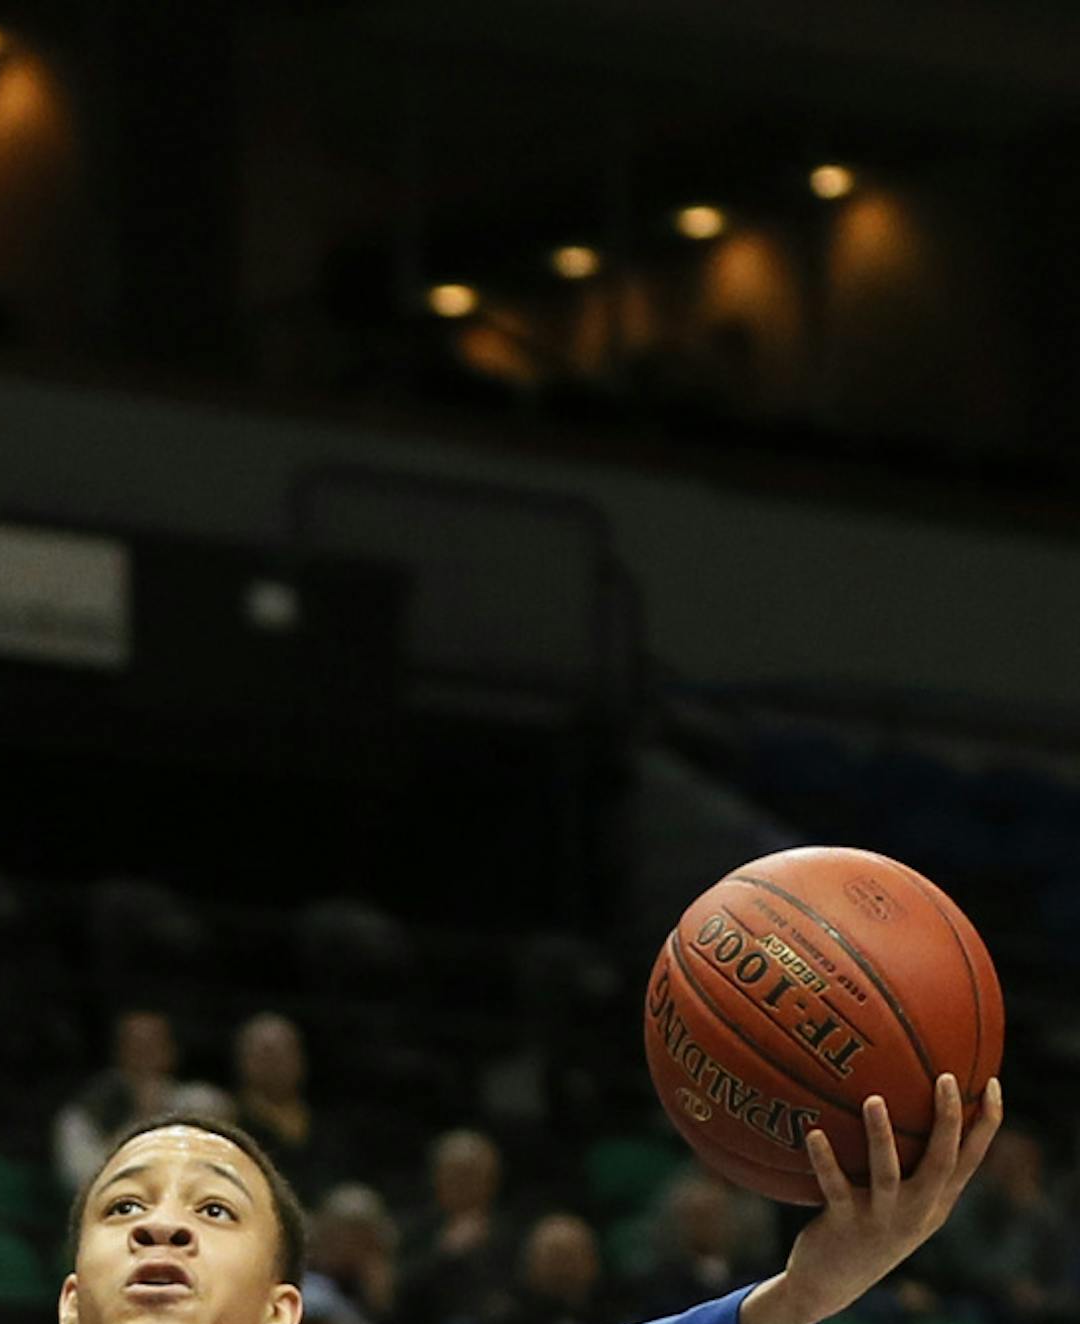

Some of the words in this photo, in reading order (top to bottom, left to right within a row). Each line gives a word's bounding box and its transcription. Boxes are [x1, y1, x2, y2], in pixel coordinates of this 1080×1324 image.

[697, 914, 864, 1077] TF-1000
[760, 935, 828, 995] LEGACY
[648, 973, 820, 1150] SPALDING
